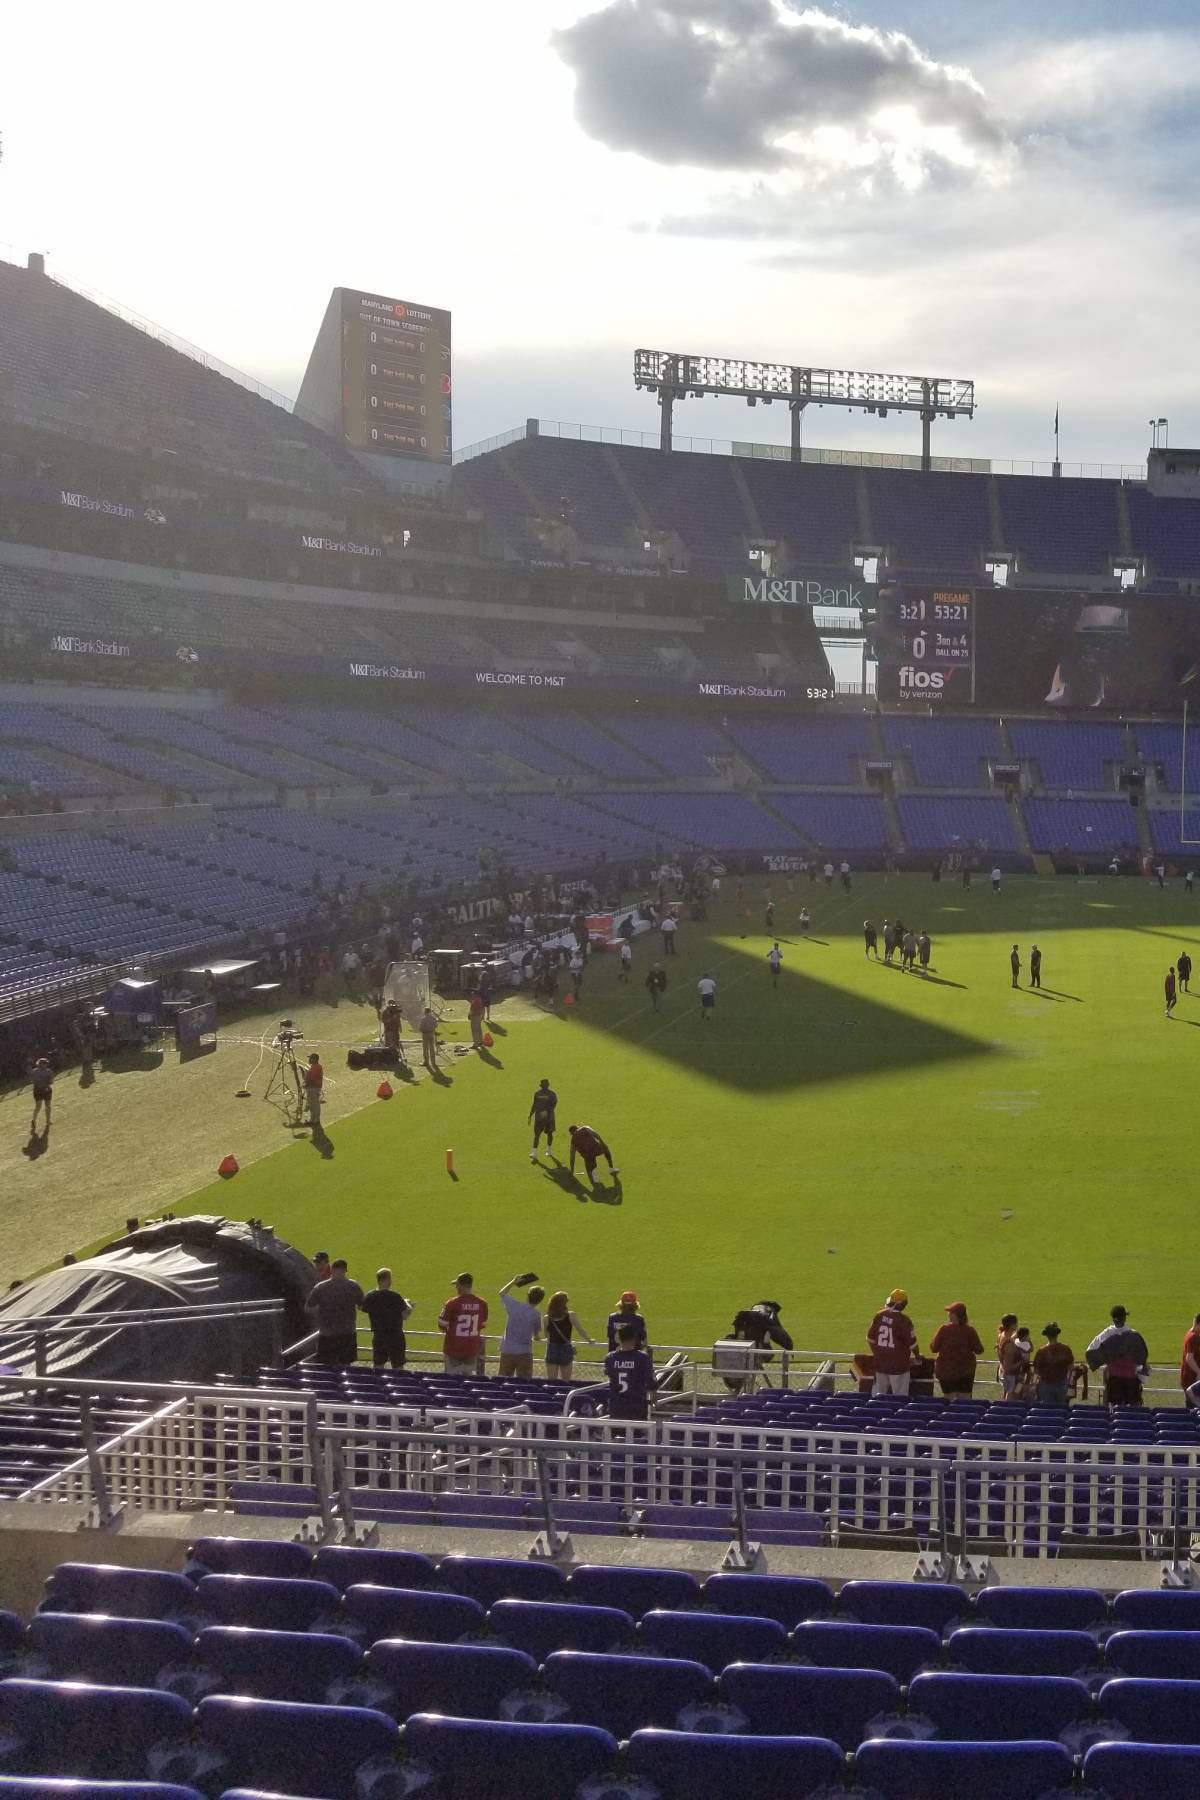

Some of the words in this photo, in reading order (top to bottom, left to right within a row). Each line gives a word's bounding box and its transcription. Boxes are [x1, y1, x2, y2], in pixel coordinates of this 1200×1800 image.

[61, 490, 82, 507] M&T
[82, 495, 103, 512] Bank
[103, 499, 135, 519] Stadium
[302, 535, 324, 549] M&T
[324, 538, 347, 552] Bank
[347, 541, 382, 558] Stadium
[743, 578, 804, 604] M&T
[806, 581, 863, 608] Bank
[933, 592, 970, 604] PREGAME
[934, 605, 967, 619] 53:21
[75, 638, 96, 653] Bank
[96, 640, 130, 657] Stadium
[913, 637, 926, 659] 0
[959, 634, 967, 646] 4
[349, 663, 370, 676] M&T
[369, 665, 390, 678] Bank
[390, 665, 426, 680] Stadium
[475, 672, 526, 686] WELCOME
[528, 675, 542, 686] TO
[544, 676, 566, 687] M&T
[899, 666, 944, 688] fios
[698, 683, 723, 695] M&T
[723, 684, 747, 696] Bank
[747, 686, 786, 698] Stadium
[806, 688, 835, 699] 53:21
[899, 690, 910, 699] by
[912, 690, 943, 699] verizon
[455, 1314, 480, 1337] 21
[878, 1325, 895, 1348] 21
[614, 1361, 635, 1369] FLACCO
[618, 1372, 629, 1393] 5
